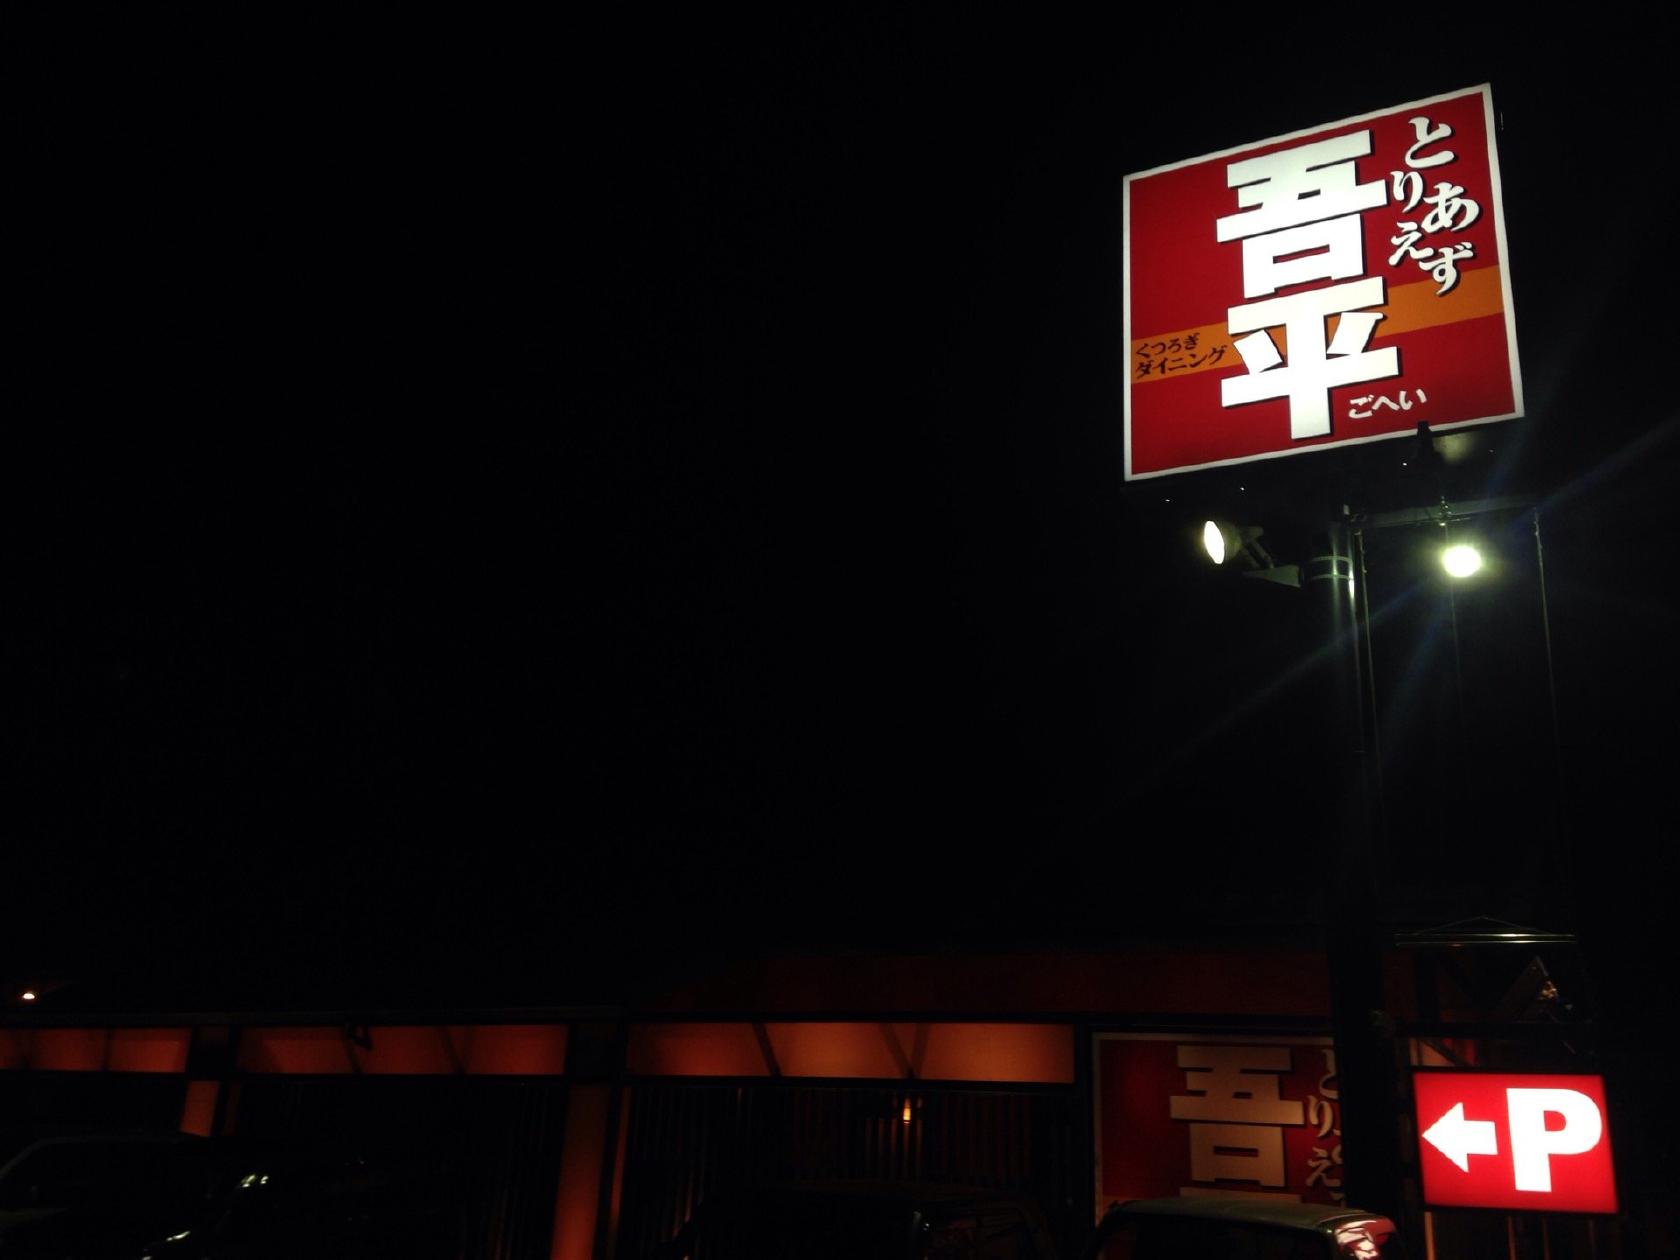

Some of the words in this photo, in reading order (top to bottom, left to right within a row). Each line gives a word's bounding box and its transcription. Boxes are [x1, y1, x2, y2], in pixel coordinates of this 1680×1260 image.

[1389, 116, 1480, 295] とりあえず
[1216, 130, 1399, 439] 吾平
[1136, 333, 1200, 358] くつろぎ
[1136, 345, 1227, 379] ダイニング
[1348, 389, 1427, 418] ごへい
[1169, 1044, 1305, 1201] 吾
[1506, 1088, 1603, 1192] P
